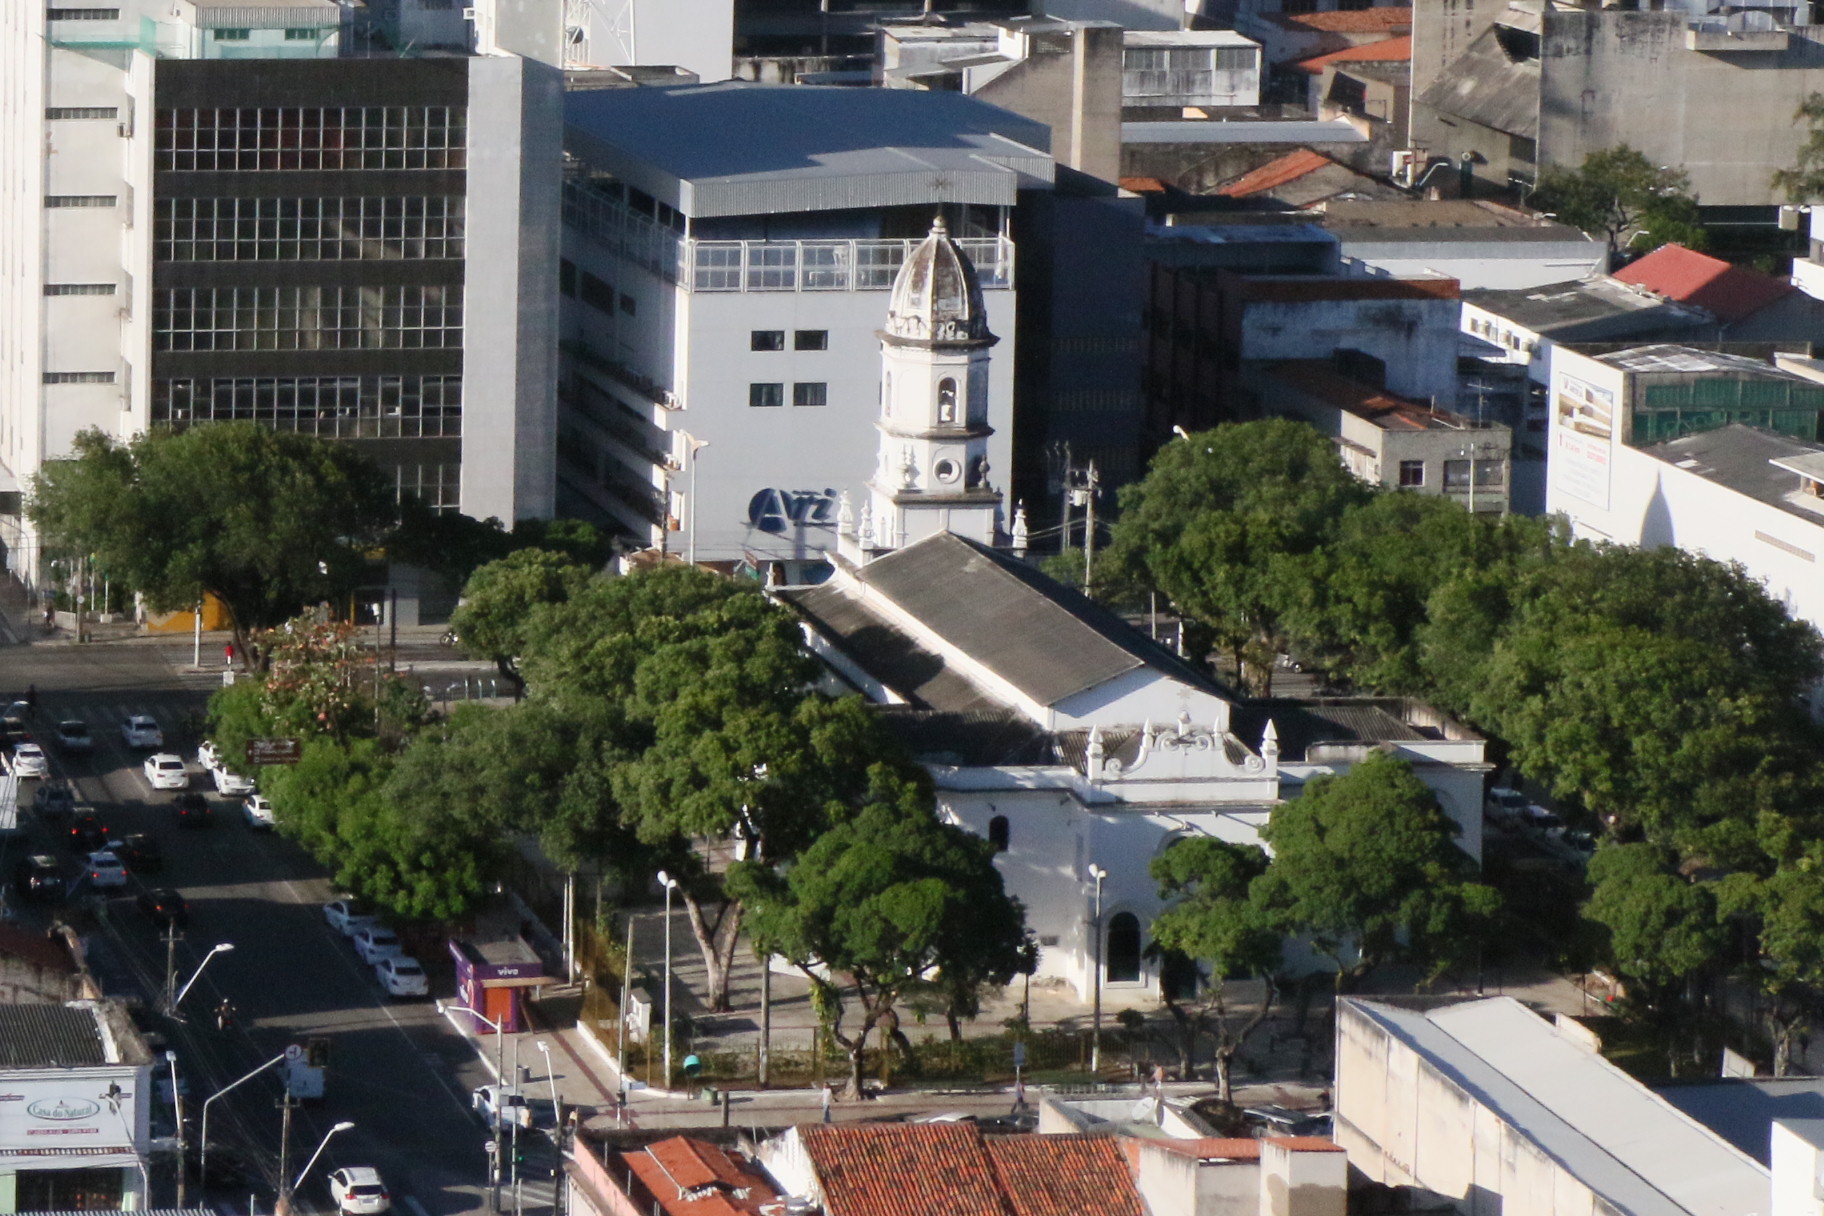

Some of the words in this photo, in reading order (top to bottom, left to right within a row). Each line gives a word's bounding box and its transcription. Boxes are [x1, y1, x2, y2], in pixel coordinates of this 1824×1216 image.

[33, 1105, 51, 1116] Casa
[53, 1108, 63, 1117] do
[65, 1104, 92, 1117] Natural
